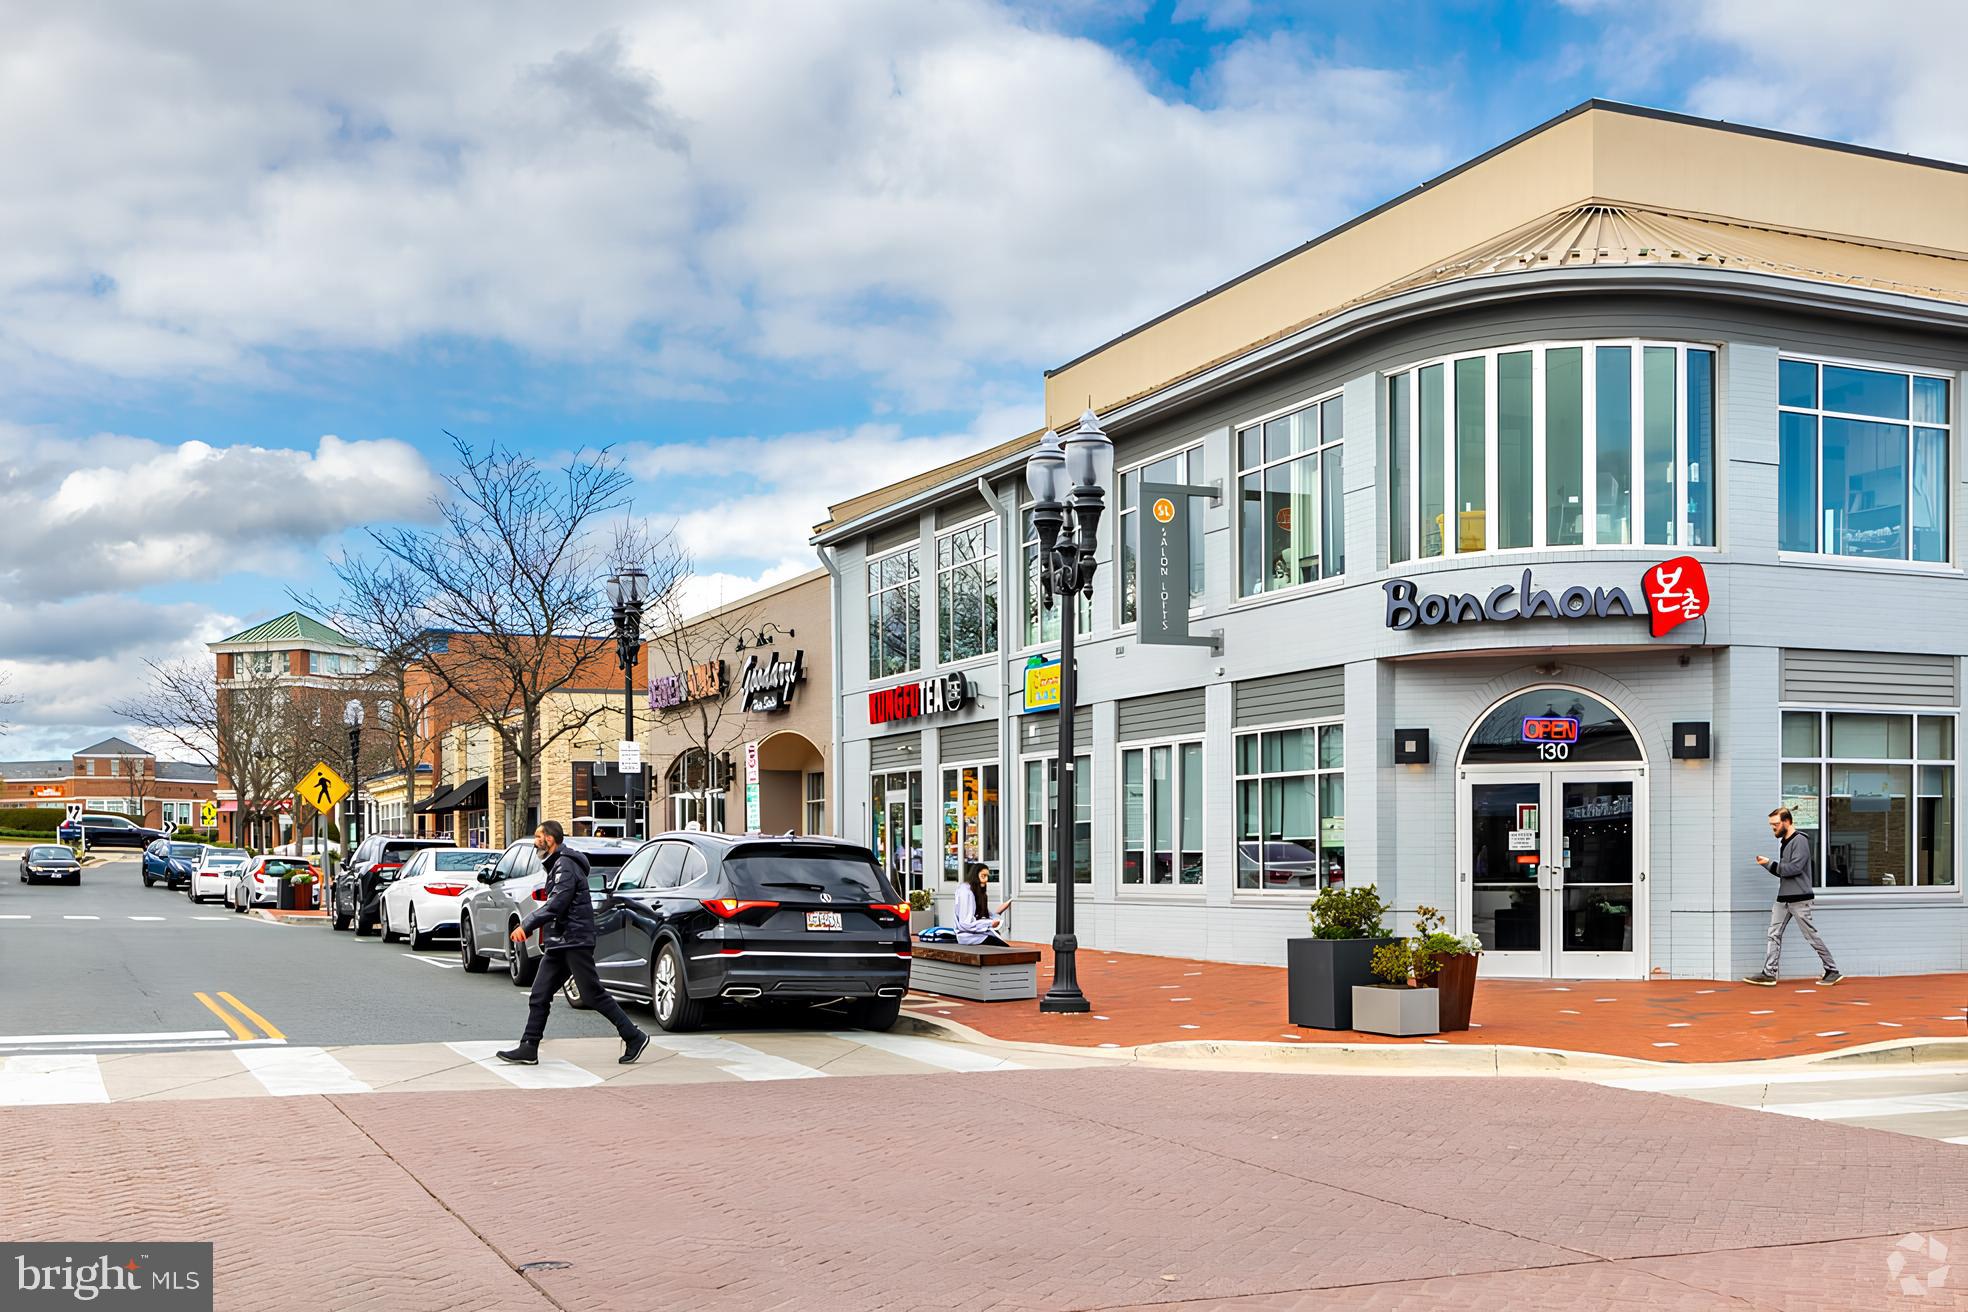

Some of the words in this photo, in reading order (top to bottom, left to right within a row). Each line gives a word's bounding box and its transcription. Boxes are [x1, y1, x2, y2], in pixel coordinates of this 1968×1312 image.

[1160, 527, 1169, 576] SALON
[1382, 568, 1634, 631] Bonchon
[1651, 566, 1701, 619] 본촌
[1524, 720, 1576, 739] OPEN
[1536, 743, 1569, 760] 130
